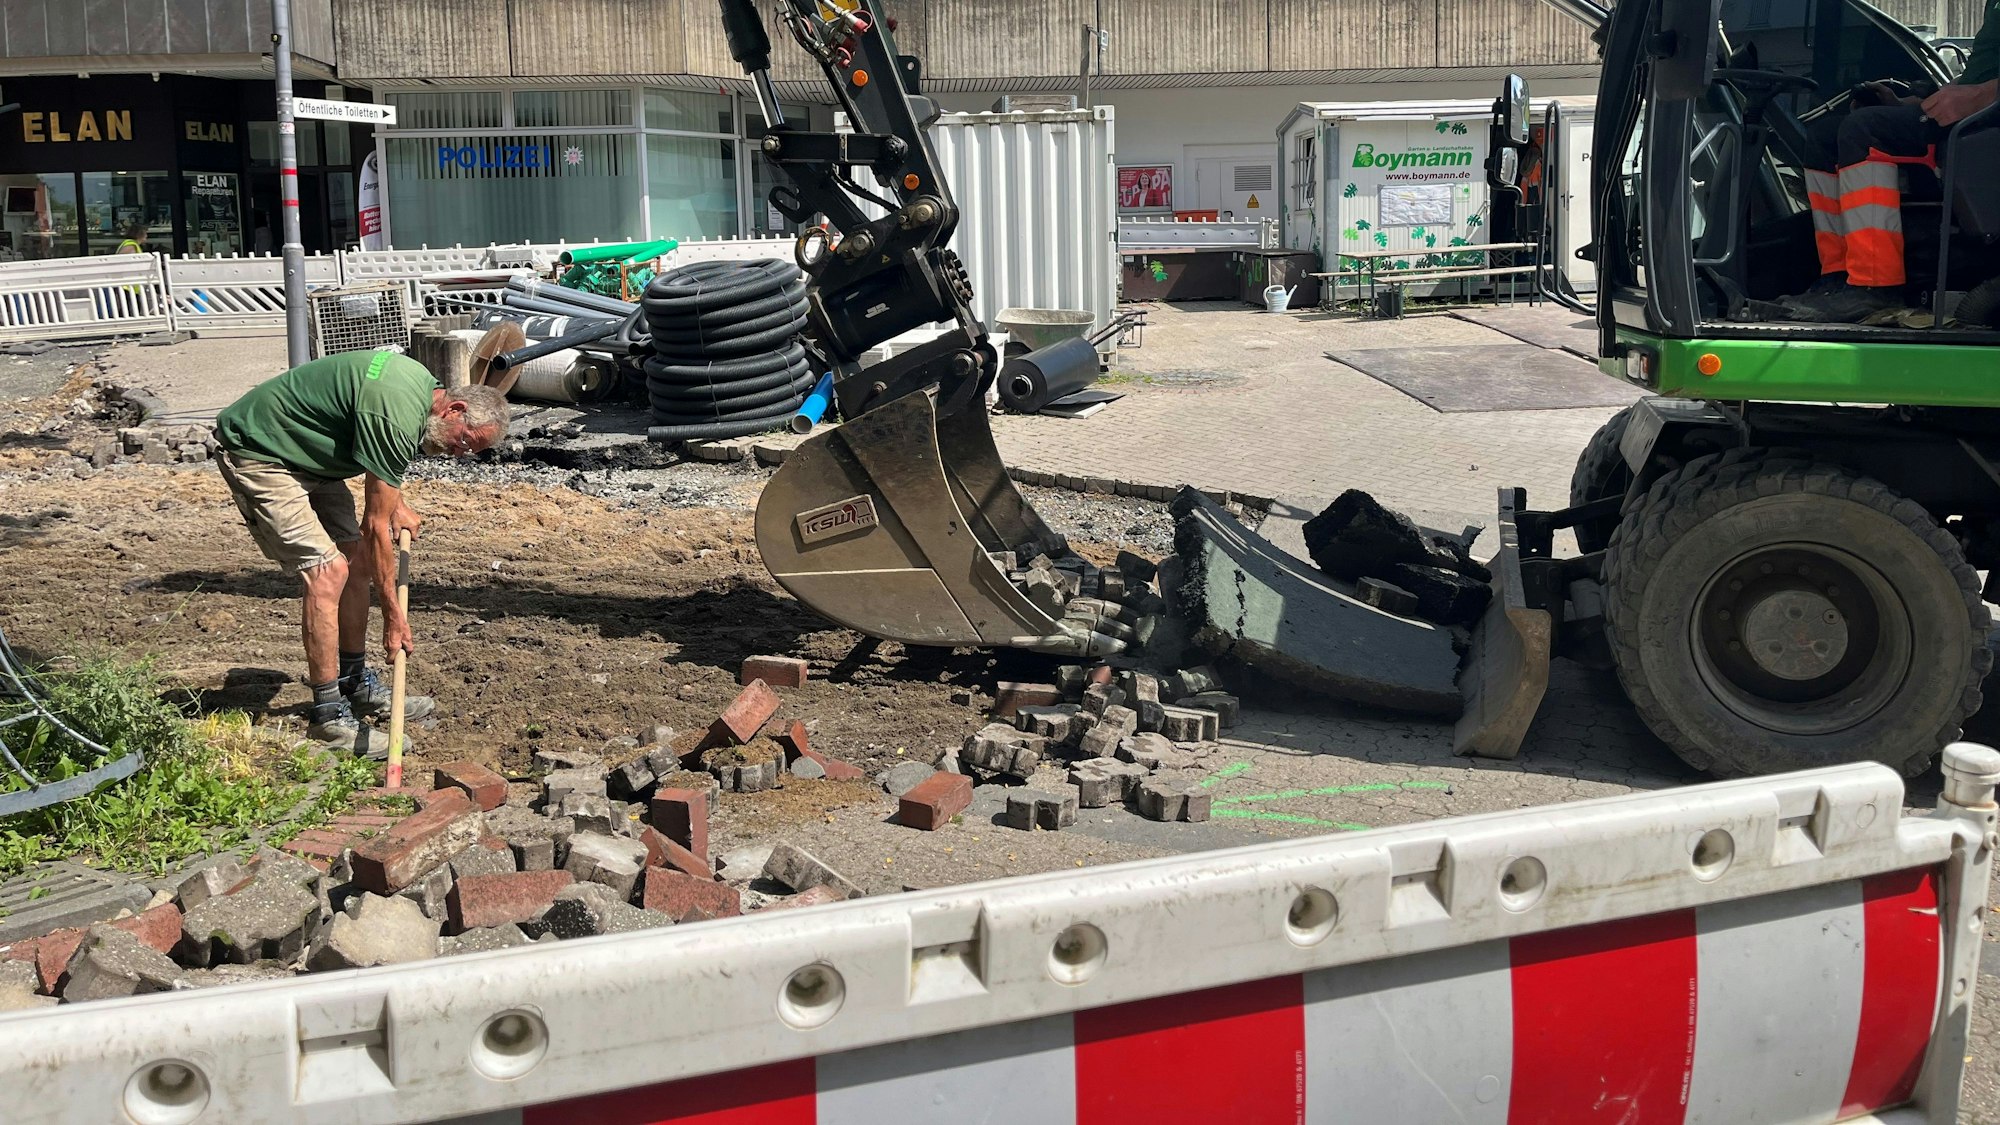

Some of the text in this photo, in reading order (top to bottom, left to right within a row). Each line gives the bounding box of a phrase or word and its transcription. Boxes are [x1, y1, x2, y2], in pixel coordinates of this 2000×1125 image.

[299, 100, 379, 118] Öffentliche Toiletten
[22, 110, 133, 143] ELAN
[185, 120, 234, 143] ELAN
[438, 144, 550, 170] POLIZEI
[1352, 143, 1473, 171] Boymann
[197, 174, 228, 188] ELAN
[1385, 171, 1471, 181] www.boymann.de
[191, 185, 234, 197] Reparaturen
[805, 511, 852, 535] KSW
